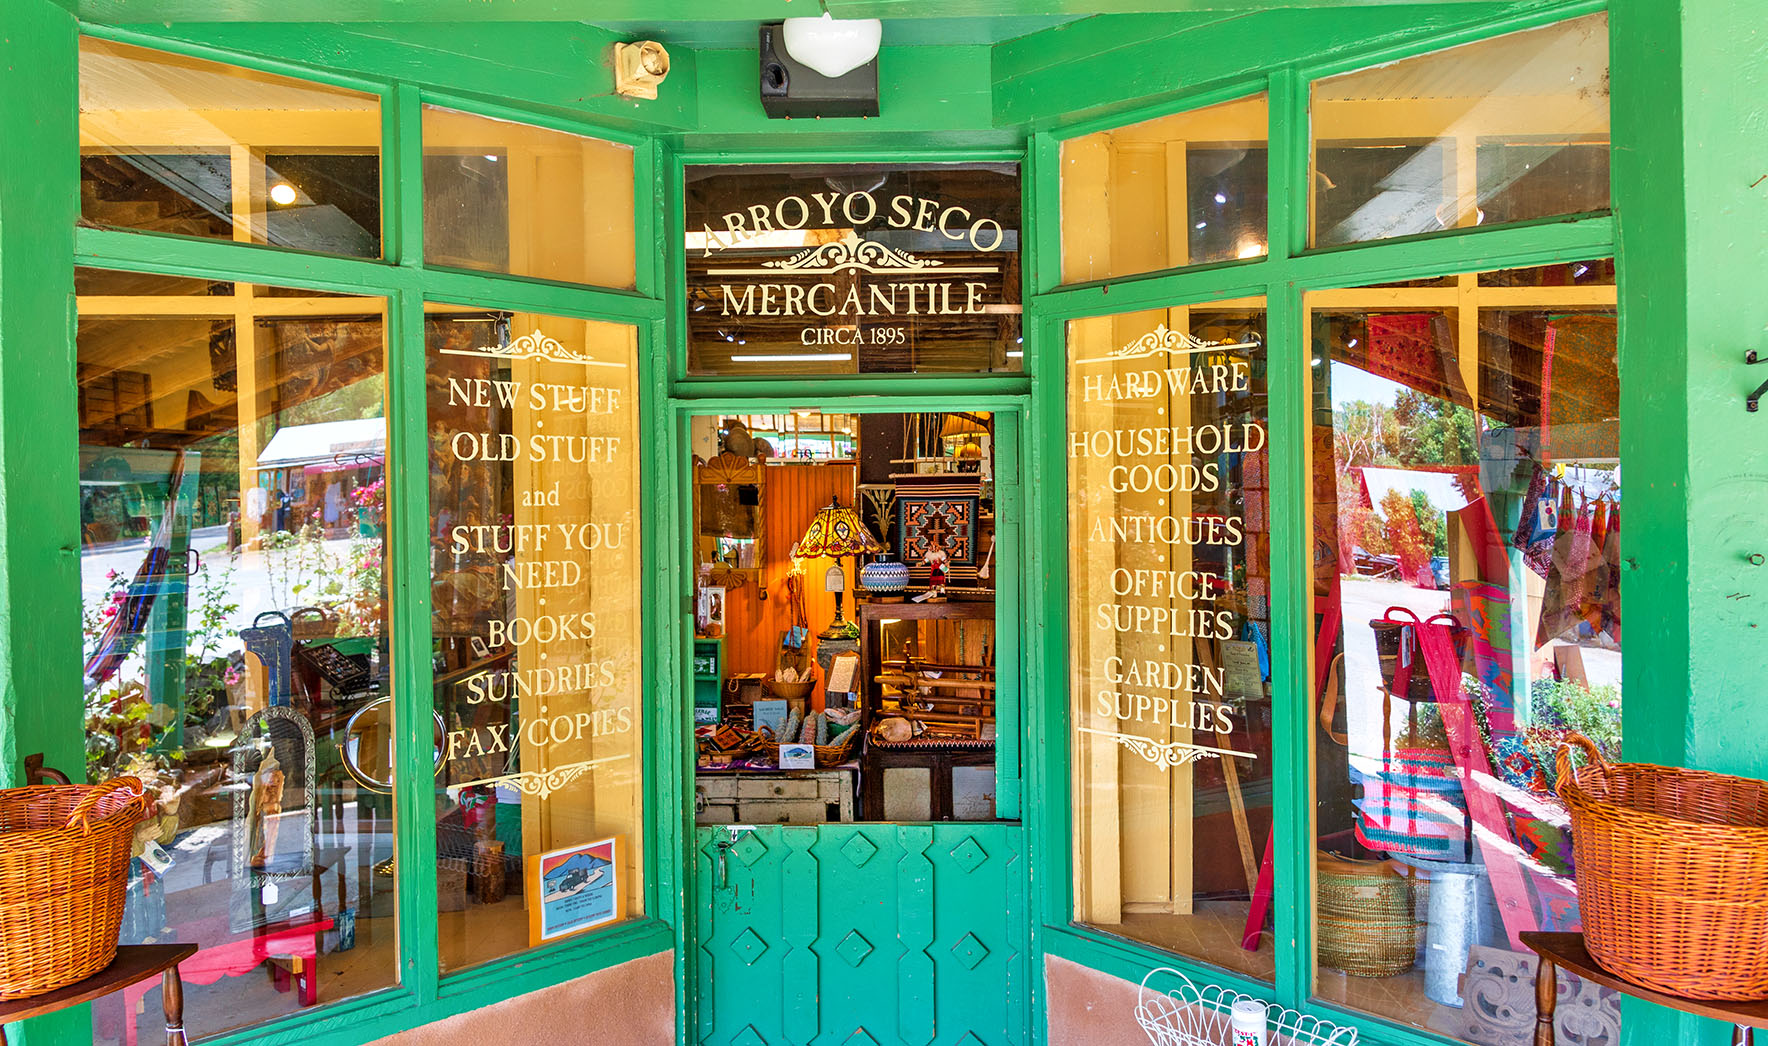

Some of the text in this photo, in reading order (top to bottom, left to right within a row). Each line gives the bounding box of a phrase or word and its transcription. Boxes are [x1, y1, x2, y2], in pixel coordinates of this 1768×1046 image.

[703, 190, 1004, 258] ARROYO SECO
[720, 282, 988, 317] MERCANTILE
[800, 327, 906, 346] CIRCA 1895
[448, 377, 621, 414] NEW STUFF
[1083, 362, 1249, 402] HARDWARE
[451, 431, 621, 463] OLD STUFF
[1069, 423, 1265, 459] HOUSEHOLD
[522, 481, 560, 507] and
[1108, 462, 1220, 493] GOODS
[451, 522, 624, 555] STUFF YOU
[1089, 516, 1244, 546] ANTIQUES
[502, 560, 581, 591] NEED
[1110, 567, 1217, 601] OFFICE
[487, 612, 596, 648] BOOKS
[1096, 603, 1234, 641] SUPPLIES
[466, 660, 615, 705] SUNDRIES
[1103, 656, 1225, 697] GARDEN
[1096, 690, 1234, 735] SUPPLIES
[447, 706, 632, 761] FAX/COPIES
